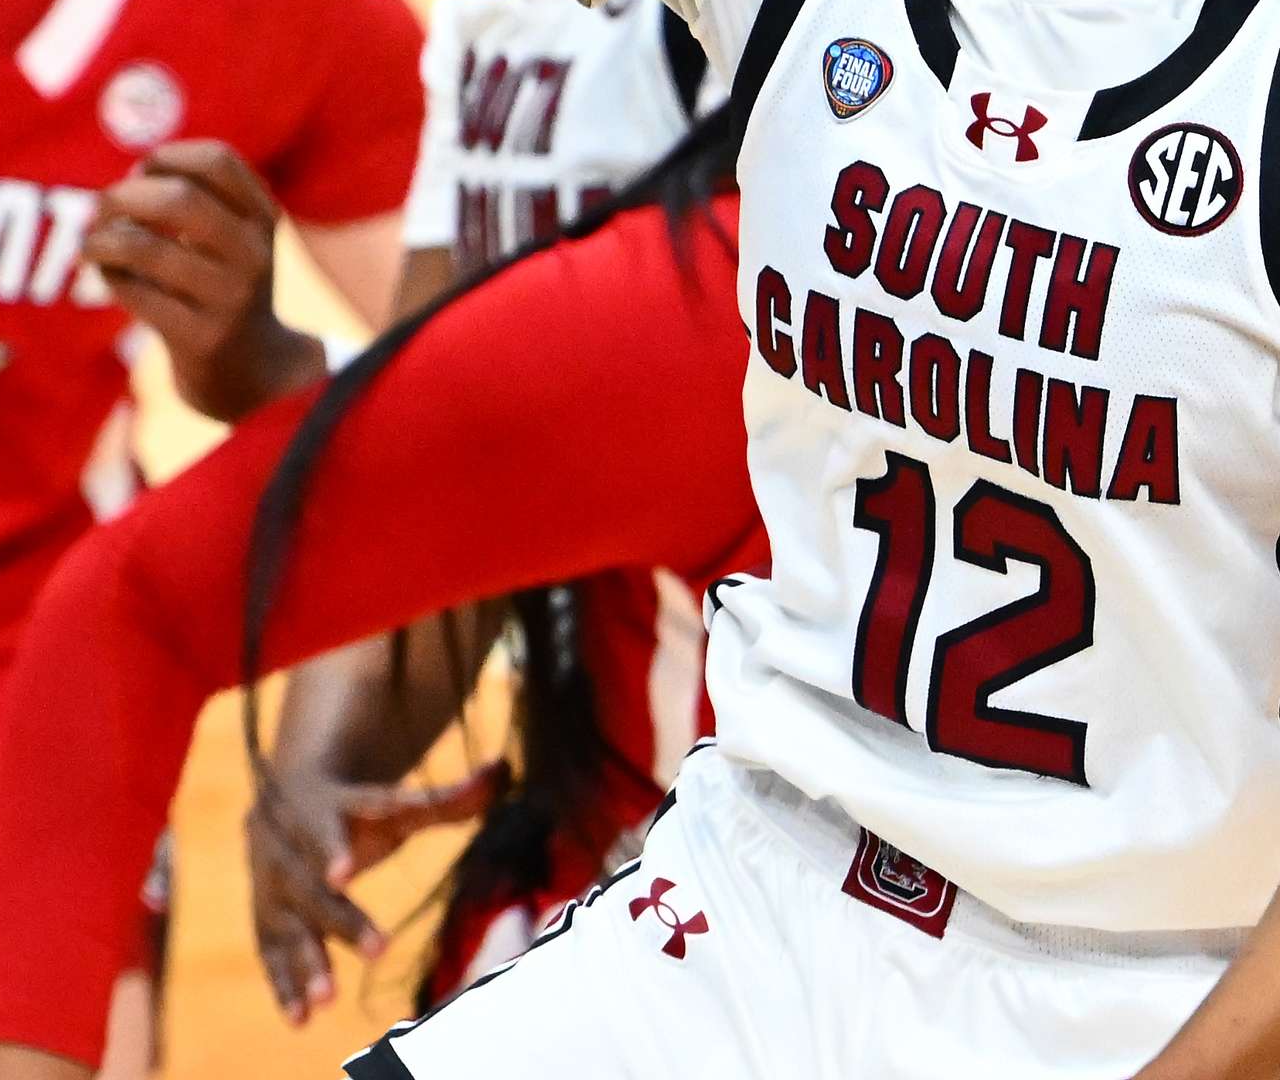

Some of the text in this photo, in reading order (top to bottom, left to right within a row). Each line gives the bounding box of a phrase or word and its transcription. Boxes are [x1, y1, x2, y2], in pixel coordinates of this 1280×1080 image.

[831, 67, 872, 98] FOUR
[838, 52, 877, 81] FINAL
[1138, 130, 1234, 228] SEC
[823, 159, 1121, 362] SOUTH
[755, 264, 1181, 506] CAROLINA
[852, 449, 1097, 789] 12
